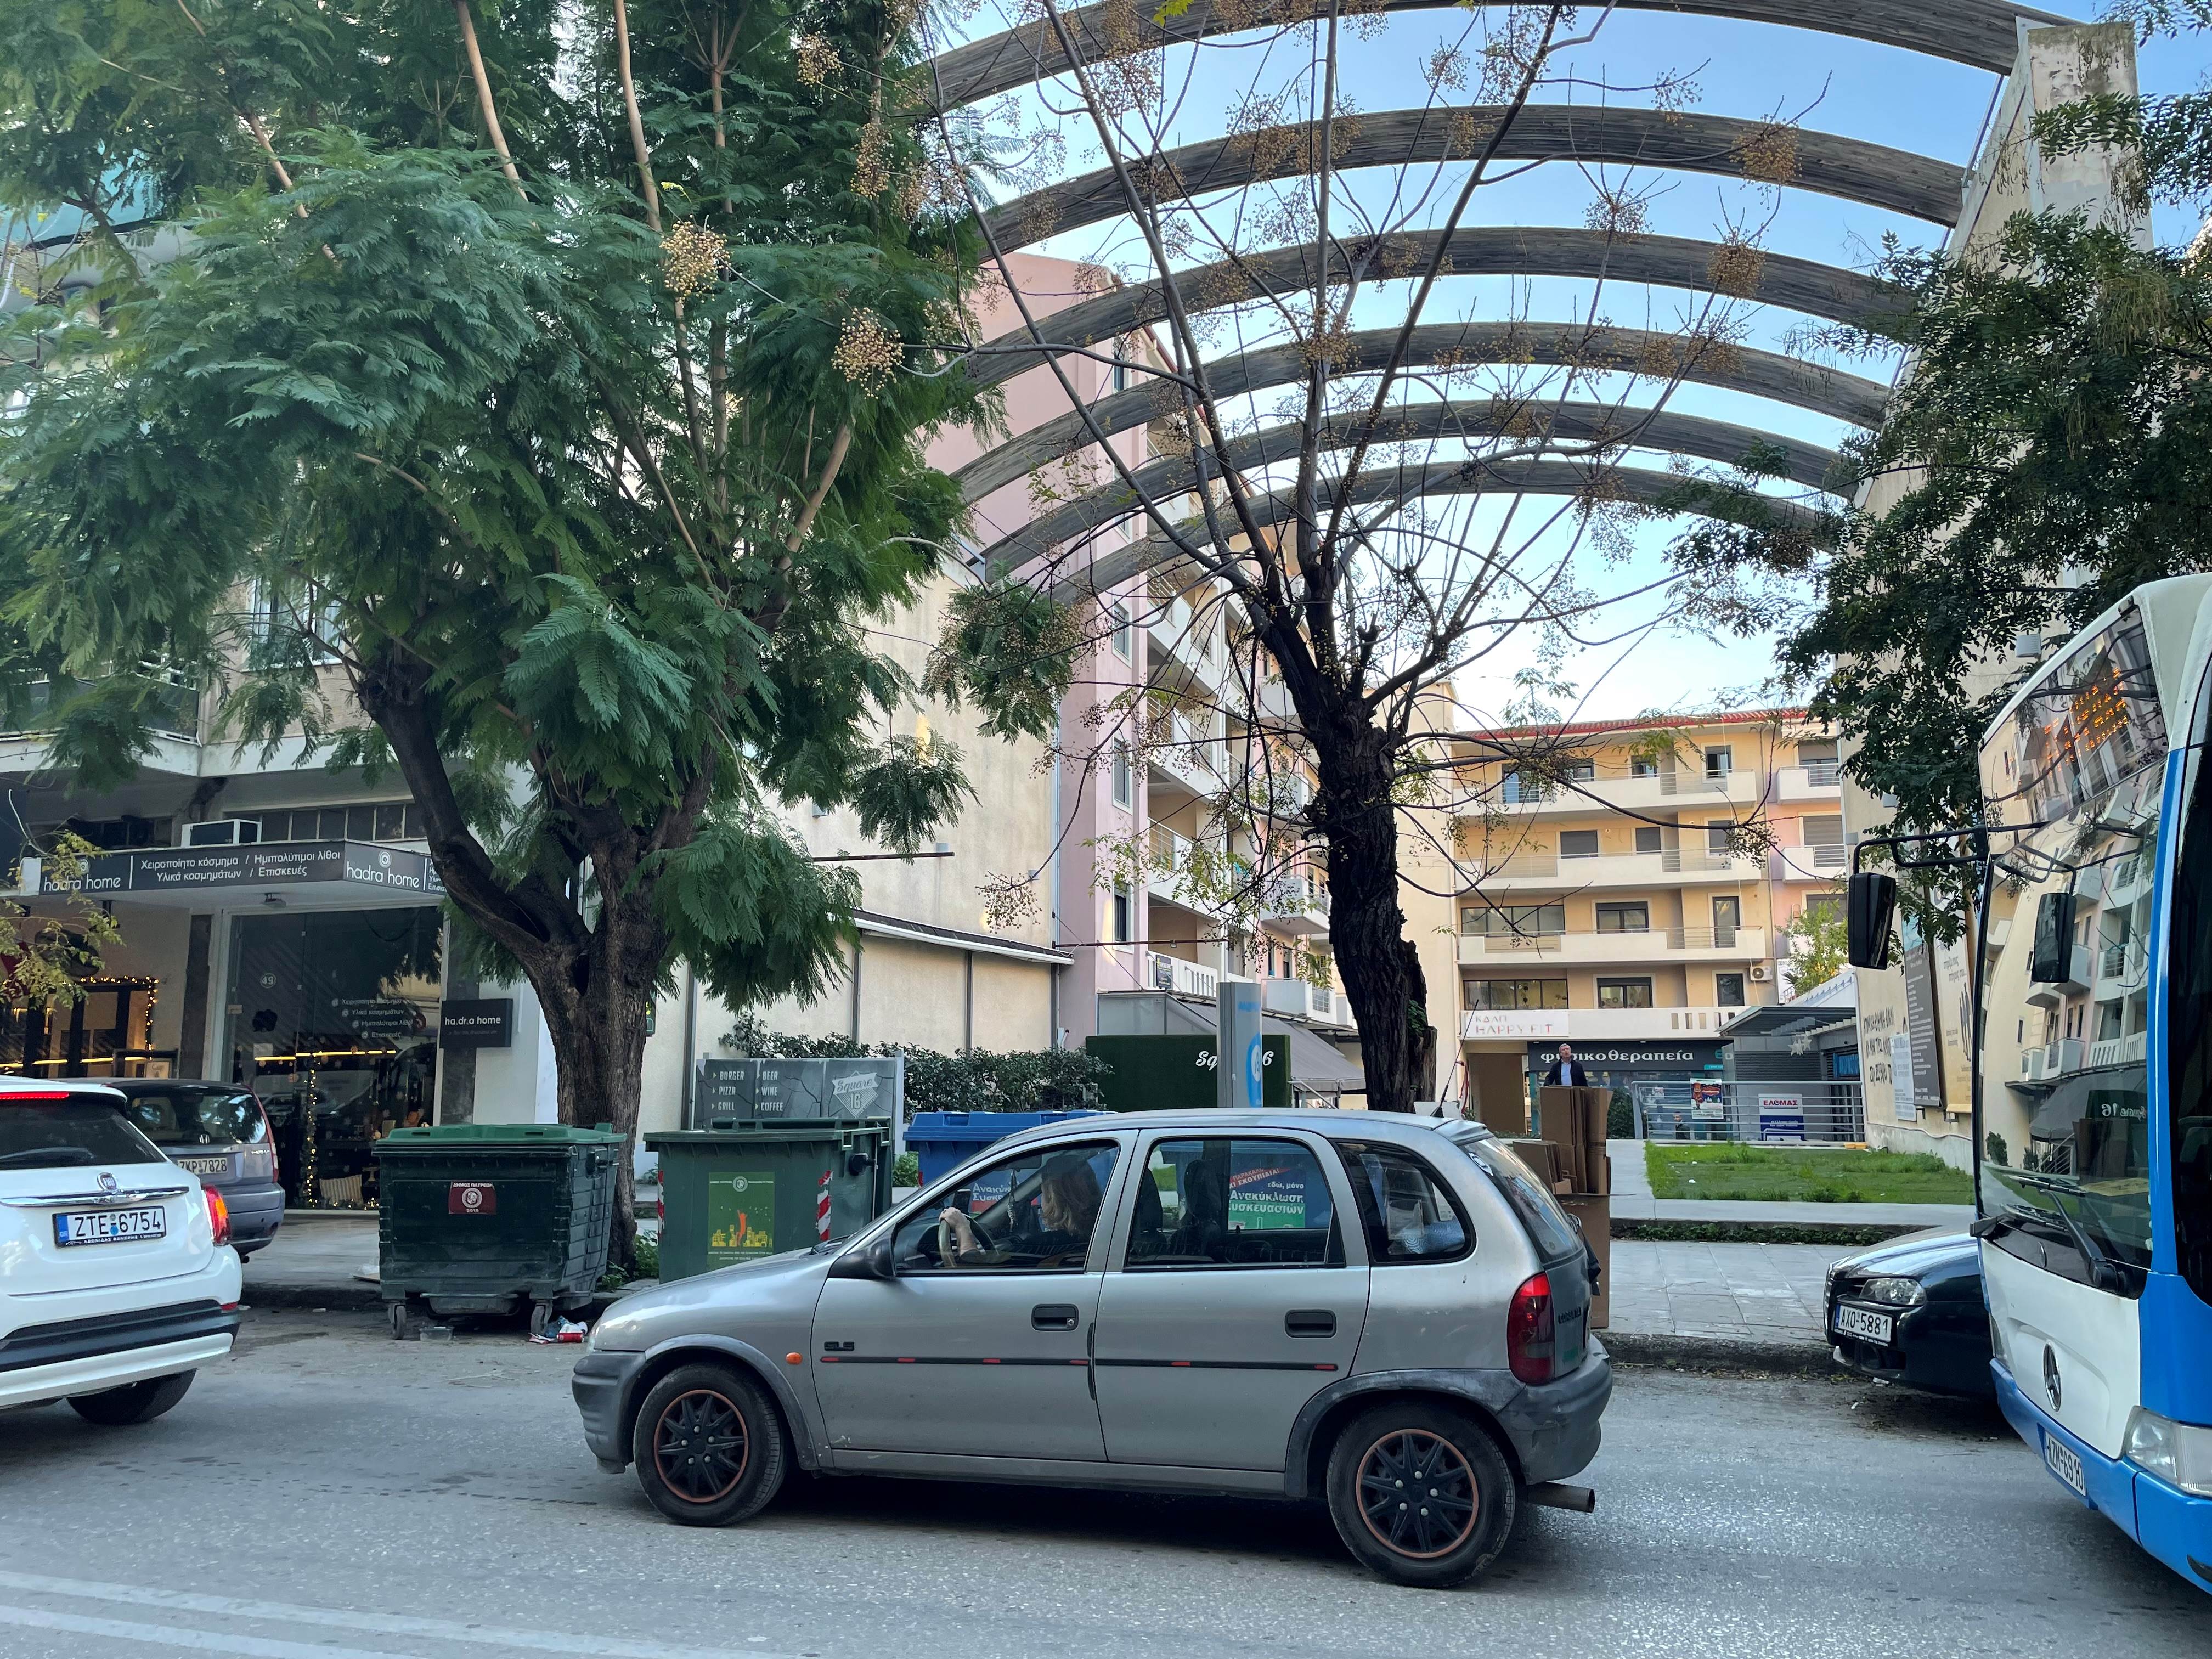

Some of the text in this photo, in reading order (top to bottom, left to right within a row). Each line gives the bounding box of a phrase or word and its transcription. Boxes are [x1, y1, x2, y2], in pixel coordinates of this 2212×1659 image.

[141, 858, 195, 870] Χειροποίητο
[198, 856, 239, 868] κόσμημα
[255, 851, 315, 865] Ημιπολύτιμοι
[318, 850, 340, 862] λίθοι
[157, 872, 181, 882] Υλικά
[184, 870, 241, 882] κοσμημάτων
[258, 865, 307, 877] Επισκευές
[346, 861, 420, 888] hadra home
[86, 874, 121, 890] home
[262, 976, 274, 985] 49
[477, 1015, 501, 1024] home
[719, 1071, 778, 1080] BURGER BEER
[719, 1086, 777, 1096] PIZZA WINE
[837, 1079, 873, 1093] Square
[718, 1102, 783, 1111] GRILL COFFEE
[1230, 1189, 1304, 1203] Ανακύκλωση
[1229, 1201, 1304, 1214] υσκευασιών
